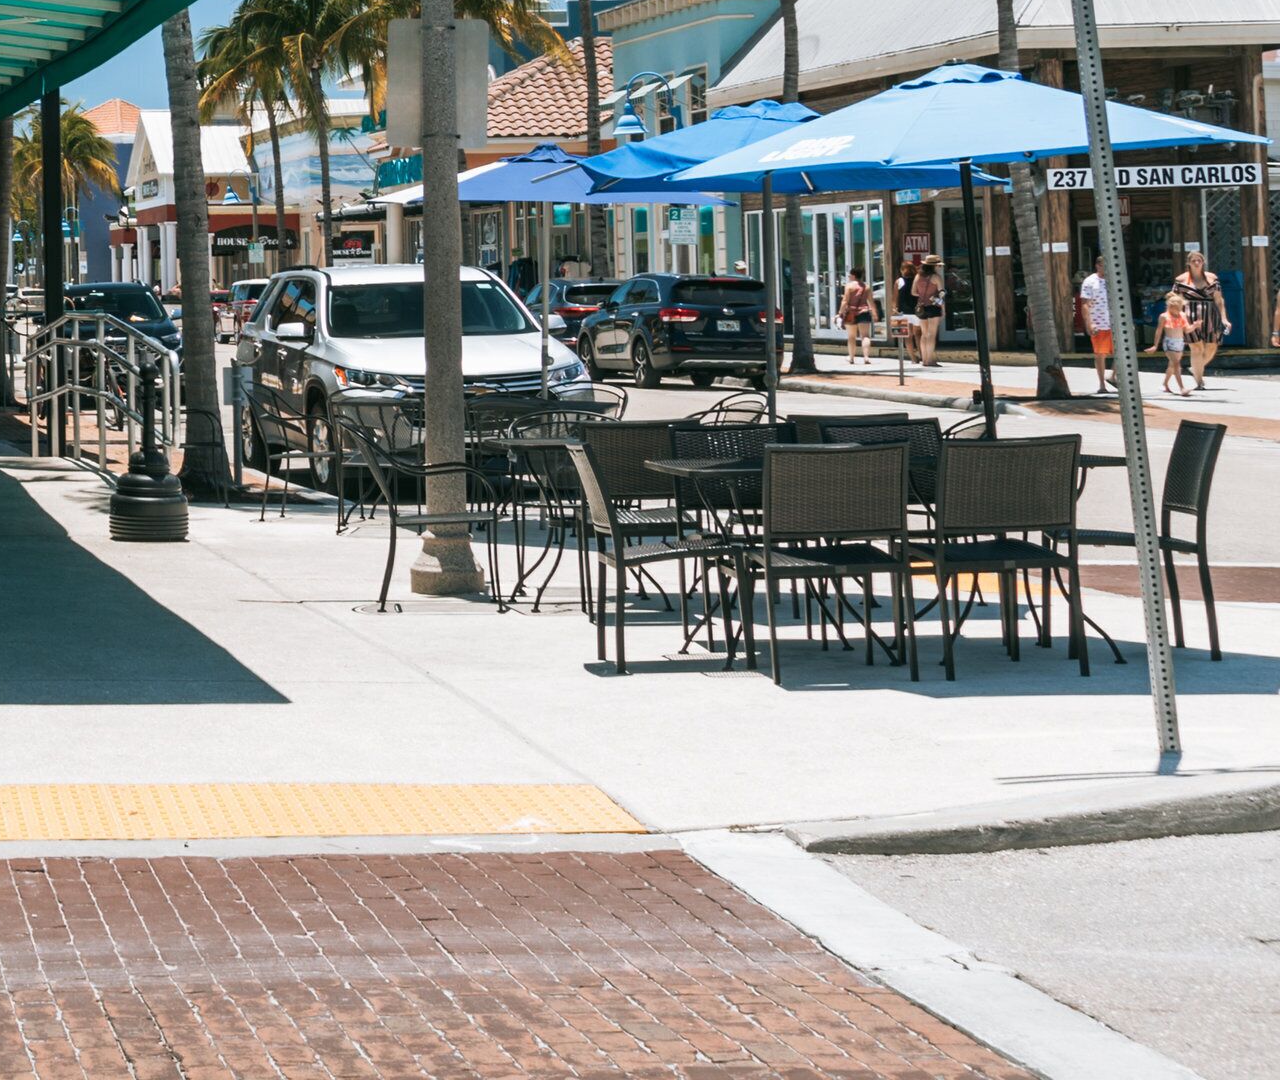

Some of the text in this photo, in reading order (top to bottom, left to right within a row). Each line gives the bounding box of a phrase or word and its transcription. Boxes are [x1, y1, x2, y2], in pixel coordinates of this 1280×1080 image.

[1053, 171, 1087, 187] 237
[1137, 167, 1174, 185] SAN
[1181, 165, 1256, 184] CARLOS
[671, 210, 679, 220] 2
[217, 237, 248, 246] HOUSE
[905, 236, 928, 251] ATM
